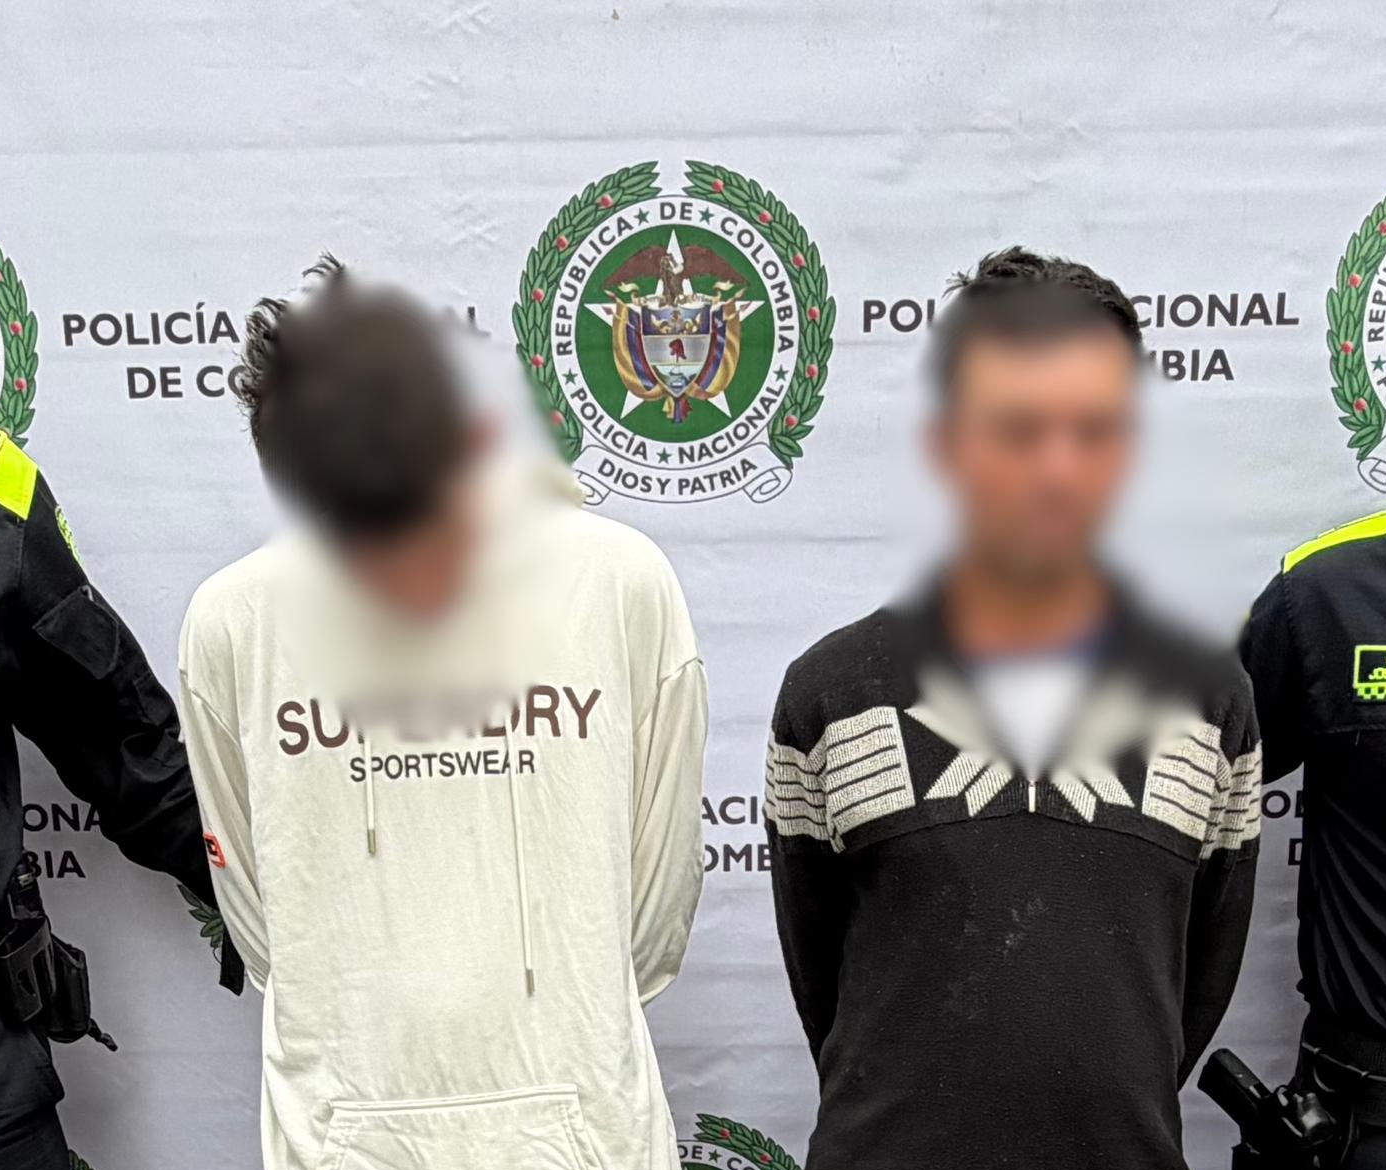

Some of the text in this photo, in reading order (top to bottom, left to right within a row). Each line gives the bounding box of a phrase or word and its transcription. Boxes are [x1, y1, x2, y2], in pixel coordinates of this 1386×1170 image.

[660, 202, 694, 221] DE
[720, 218, 794, 353] COLOMBIA
[63, 302, 240, 346] POLICÍA
[127, 367, 183, 398] DE
[570, 385, 785, 464] POLICÍA NACIONAL
[597, 458, 759, 495] DIOS Y PATRIA
